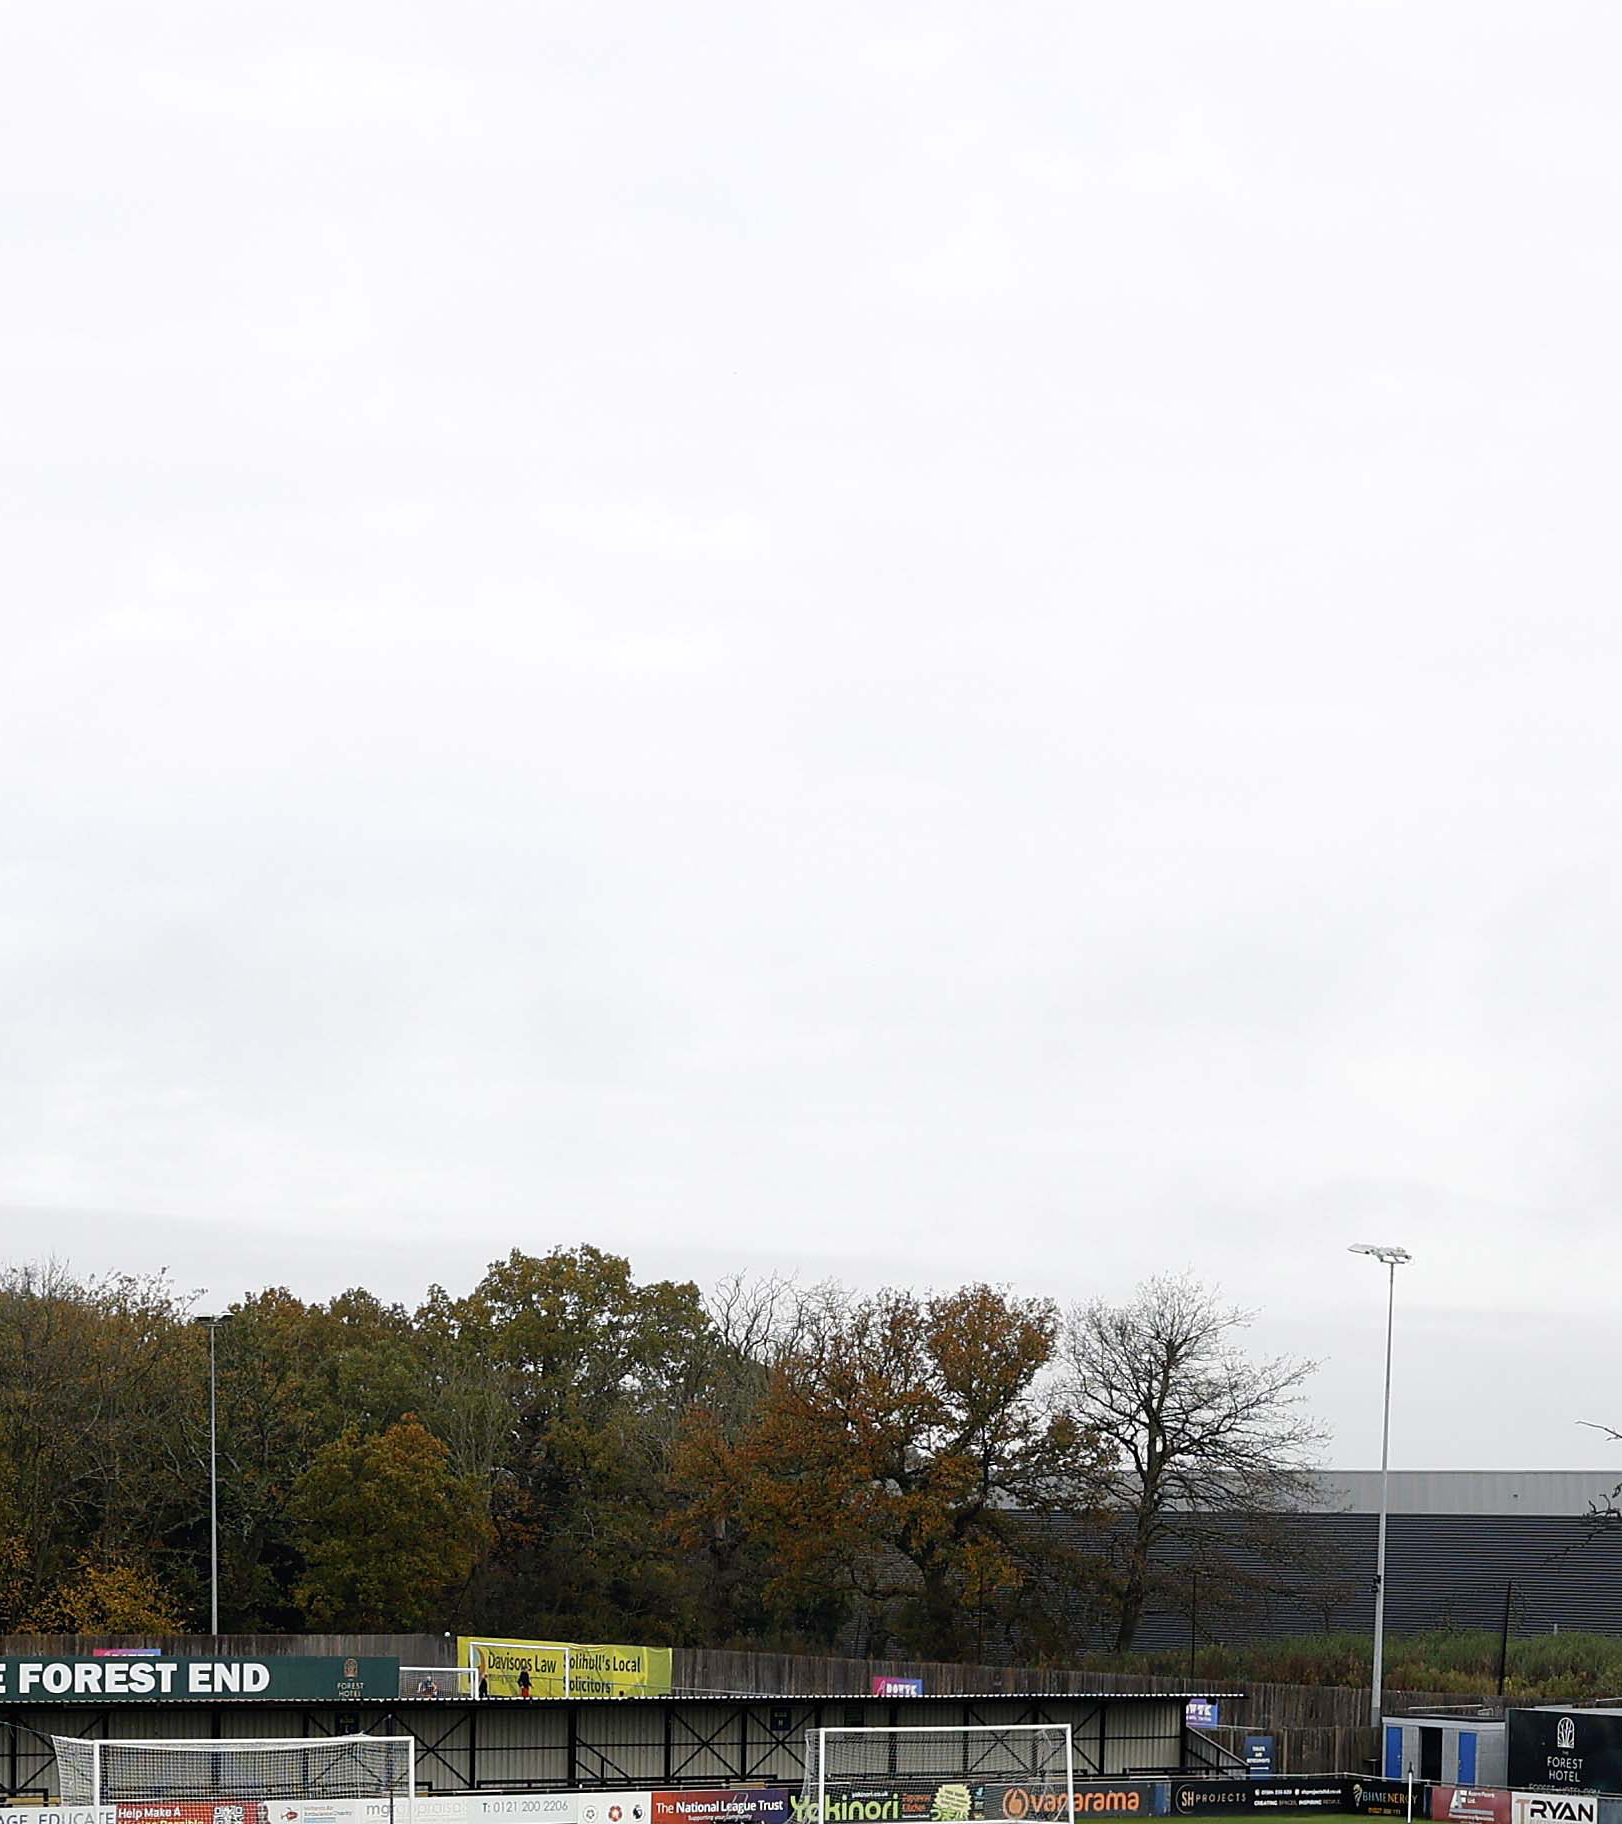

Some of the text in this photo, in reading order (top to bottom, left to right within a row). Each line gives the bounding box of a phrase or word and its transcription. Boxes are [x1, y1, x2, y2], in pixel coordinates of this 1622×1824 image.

[488, 1652, 557, 1673] Davisons Law
[613, 1656, 641, 1673] Local
[19, 1662, 178, 1693] FOREST
[189, 1662, 270, 1693] END
[337, 1682, 364, 1690] FOREST
[338, 1690, 362, 1698] HOTEL
[1185, 1704, 1212, 1715] WTK
[1547, 1756, 1583, 1769] FOREST
[1549, 1769, 1581, 1782] HOTEL
[1031, 1789, 1140, 1813] vanarama
[1182, 1791, 1194, 1807] SH
[1196, 1791, 1247, 1803] PROJECTS
[118, 1807, 182, 1820] Help Make A
[493, 1801, 520, 1813] 0121
[522, 1801, 542, 1812] 200
[545, 1800, 569, 1812] 2206
[656, 1798, 783, 1816] The National League Trust
[790, 1793, 899, 1822] Yokinori
